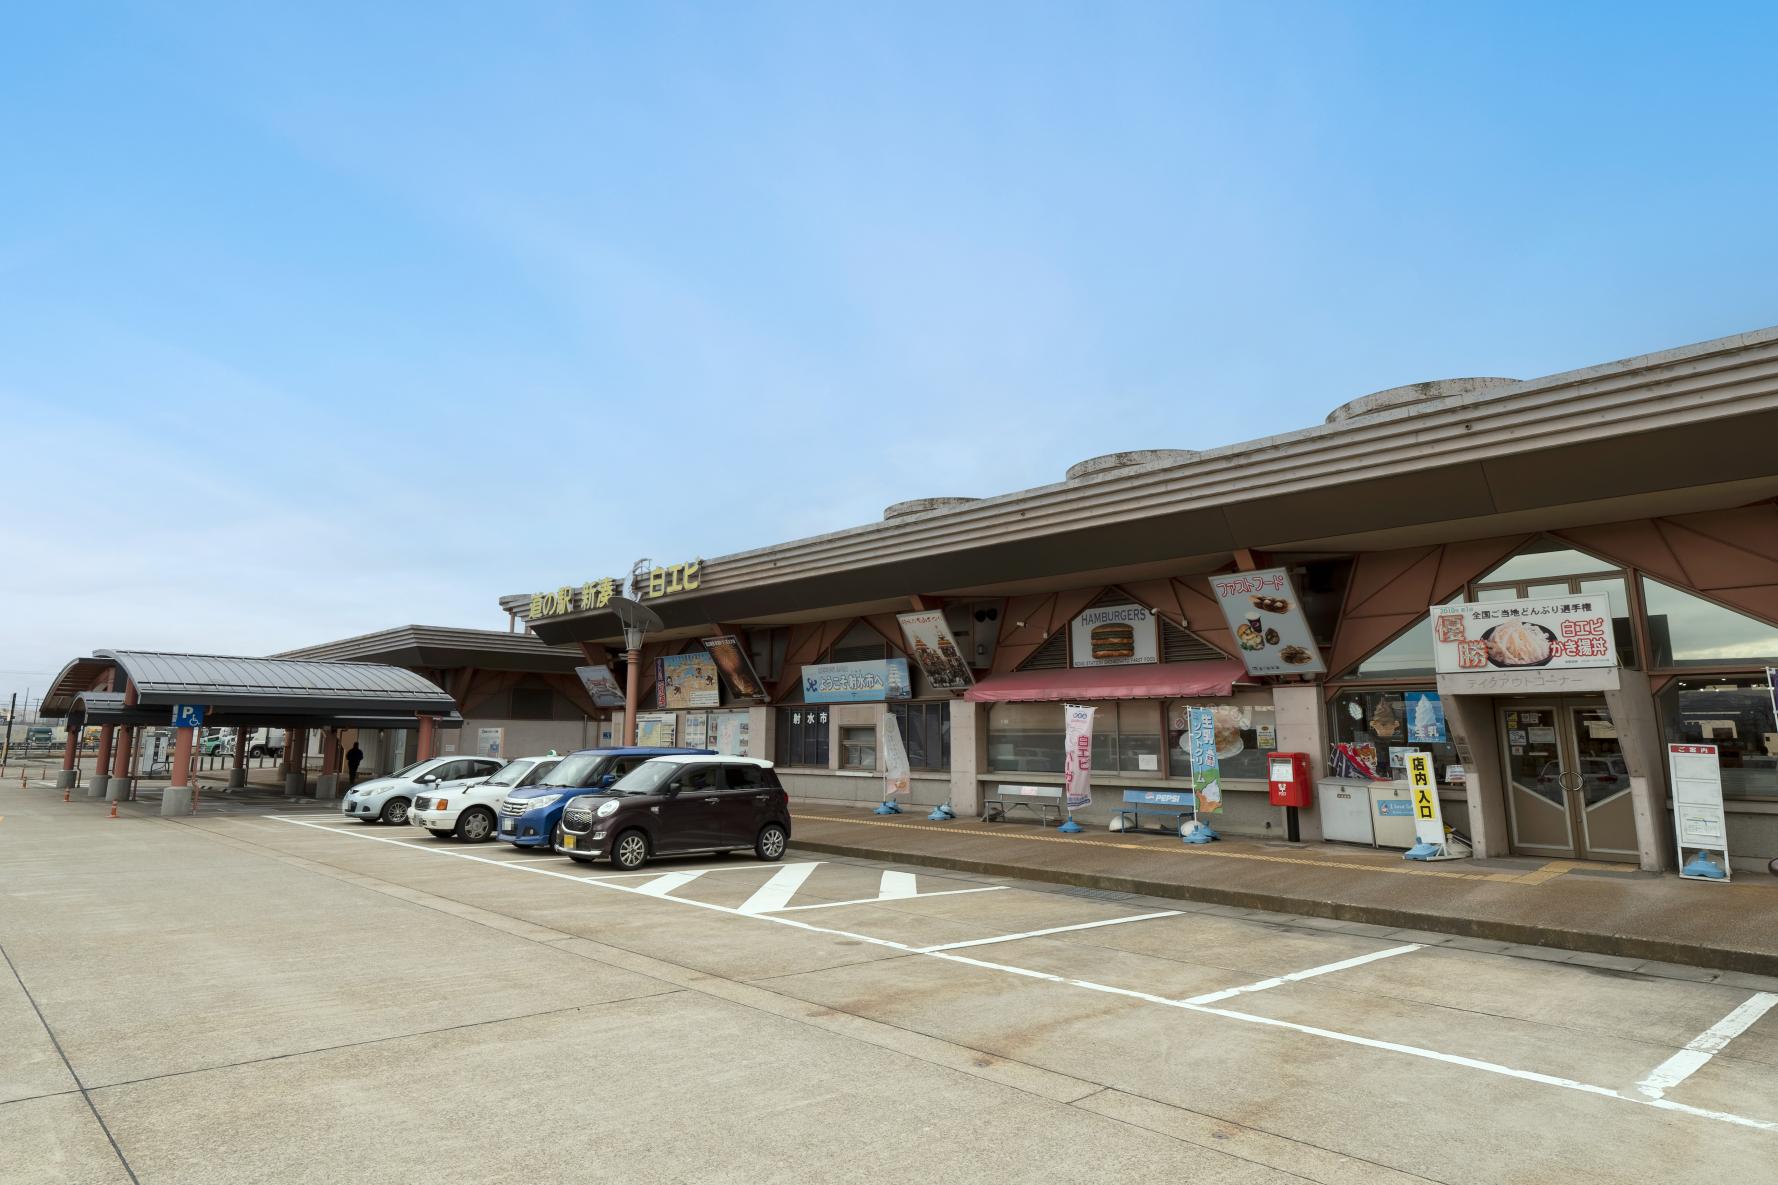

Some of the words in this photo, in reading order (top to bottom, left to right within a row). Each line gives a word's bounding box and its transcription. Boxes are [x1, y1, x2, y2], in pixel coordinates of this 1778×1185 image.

[649, 557, 704, 598] 白エビ
[1216, 574, 1284, 598] ファストフード
[528, 586, 574, 619] 道の駅
[1472, 602, 1593, 620] 全国ご当地どんぶり選手権
[1081, 608, 1147, 627] HAMBURGERS
[1560, 617, 1605, 638] 白エビ
[1550, 637, 1608, 659] かき揚丼
[182, 706, 194, 719] P
[793, 712, 828, 725] 射水市
[1155, 794, 1181, 803] PEPSI
